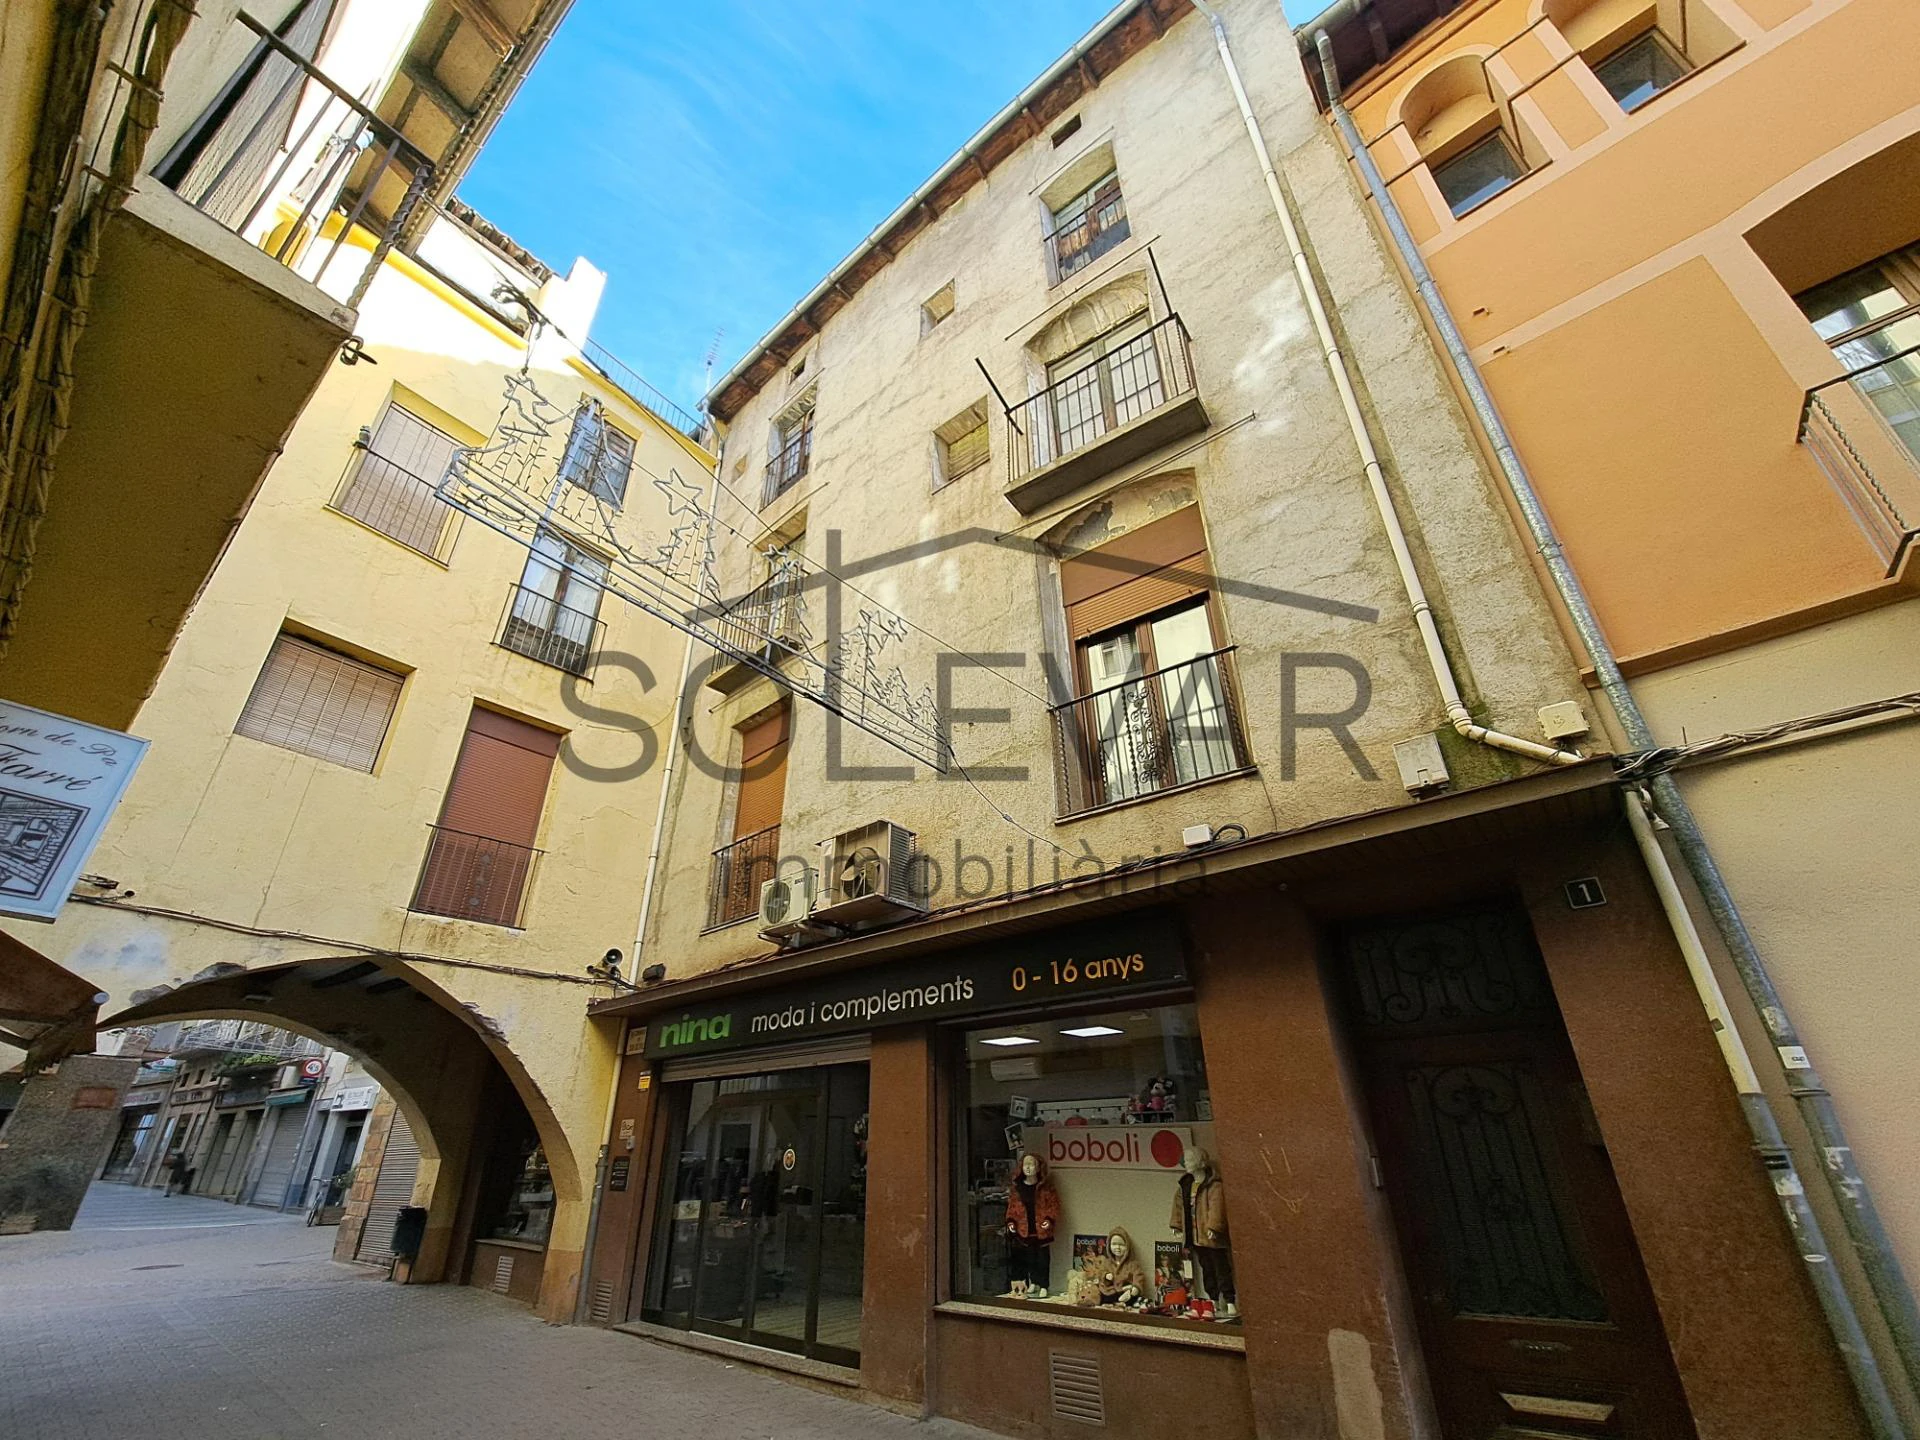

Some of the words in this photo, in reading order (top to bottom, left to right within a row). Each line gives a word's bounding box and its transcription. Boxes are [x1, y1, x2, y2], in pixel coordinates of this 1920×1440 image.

[44, 732, 77, 746] de
[80, 743, 117, 767] Pa
[1578, 883, 1592, 902] 1
[1012, 967, 1026, 991] 0
[1050, 958, 1078, 985] 16
[1085, 953, 1144, 980] anys
[659, 1013, 731, 1048] nina
[751, 1006, 804, 1033] moda
[810, 1001, 816, 1024] i
[820, 975, 974, 1021] complements
[1049, 1132, 1140, 1163] boboli
[1156, 1244, 1180, 1253] boboli
